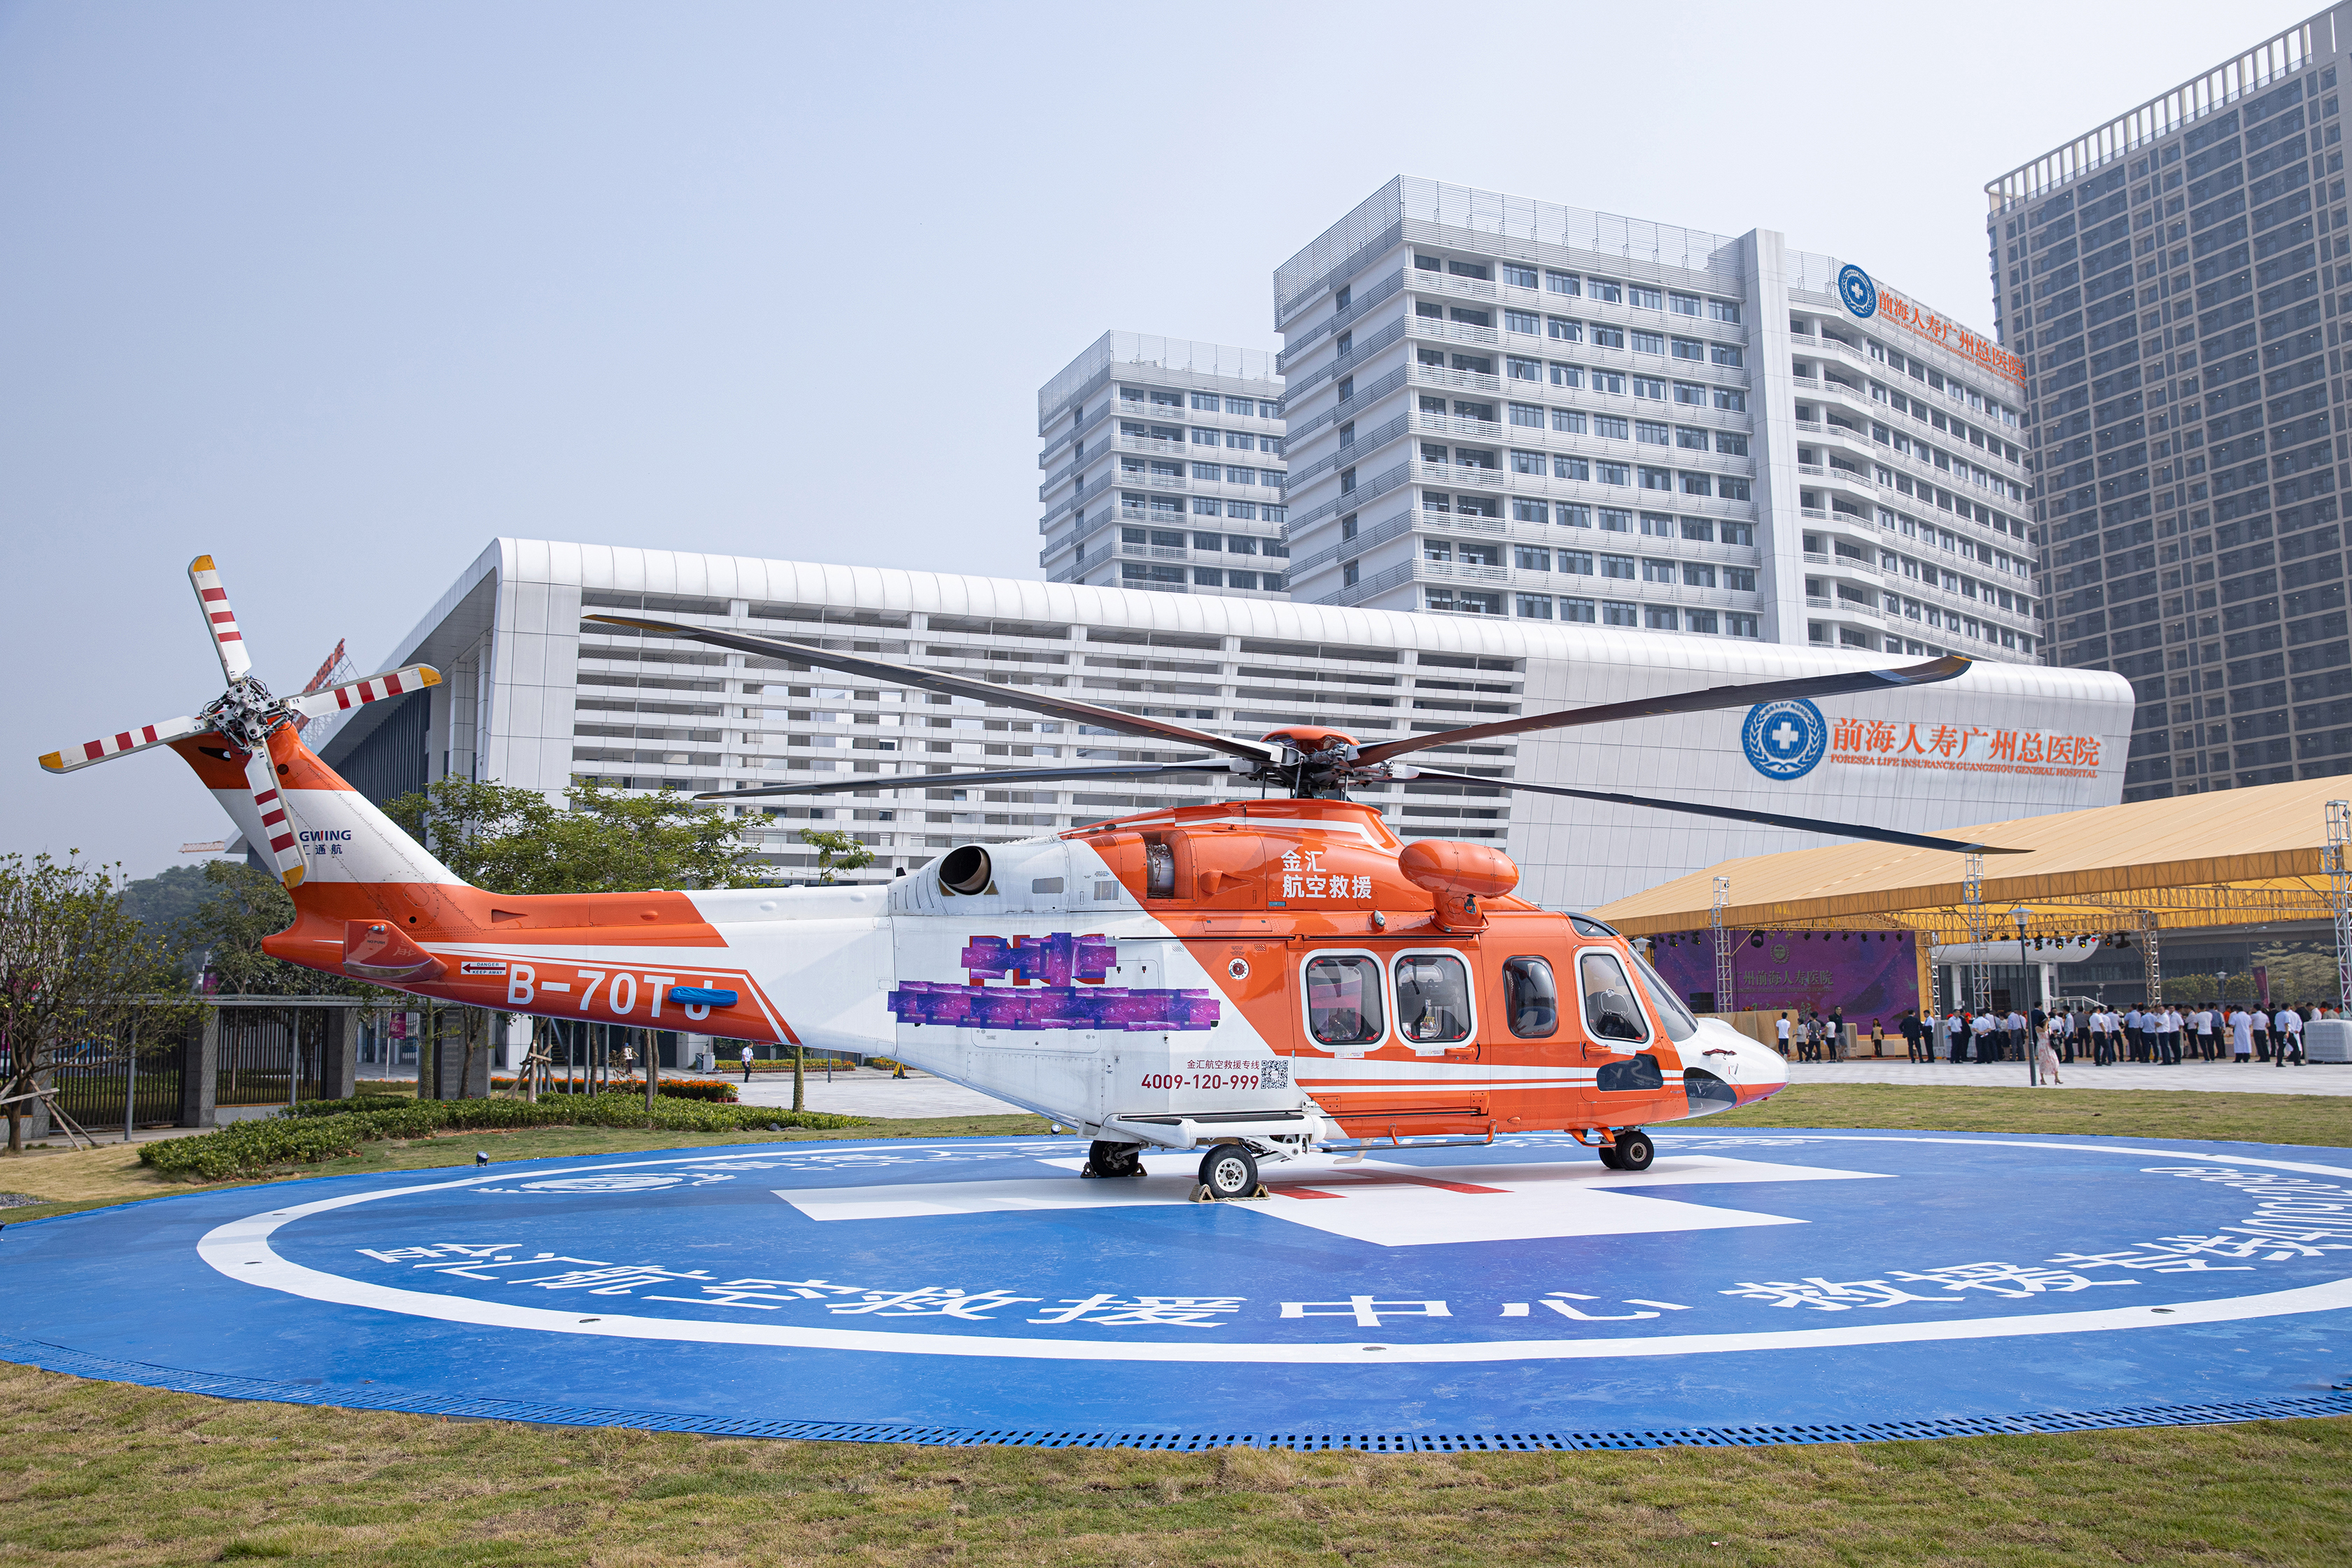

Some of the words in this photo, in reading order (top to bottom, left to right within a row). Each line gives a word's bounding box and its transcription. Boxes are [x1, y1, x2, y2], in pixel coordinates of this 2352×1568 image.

[1878, 290, 2026, 381] 前海人寿广州总医院
[1878, 310, 1900, 326] FORESEA
[1901, 321, 1913, 332] LIFE
[1913, 328, 1942, 346] INSURANCE
[1942, 342, 1975, 363] GUANGZHOU
[1975, 359, 2000, 376] GENERAL
[2000, 371, 2026, 389] HOSPITAL
[1833, 718, 2101, 766] 前海人寿广州总医院
[1830, 753, 1875, 766] FORESEA
[1877, 756, 1900, 767] LIFE
[1900, 758, 1956, 771] INSURANCE
[1956, 761, 2013, 774] GUANGZHOU
[2015, 765, 2055, 776] GENERAL
[2056, 767, 2098, 778] HOSPITAL
[1280, 849, 1326, 872] 金汇
[1282, 874, 1372, 899] 航空救援
[1731, 969, 1834, 986] 广州前海人寿医院
[1186, 1060, 1260, 1070] 金汇航空救援专线
[1141, 1074, 1259, 1089] 4009-120-999
[356, 1242, 1693, 1327] 金汇航空救援中心
